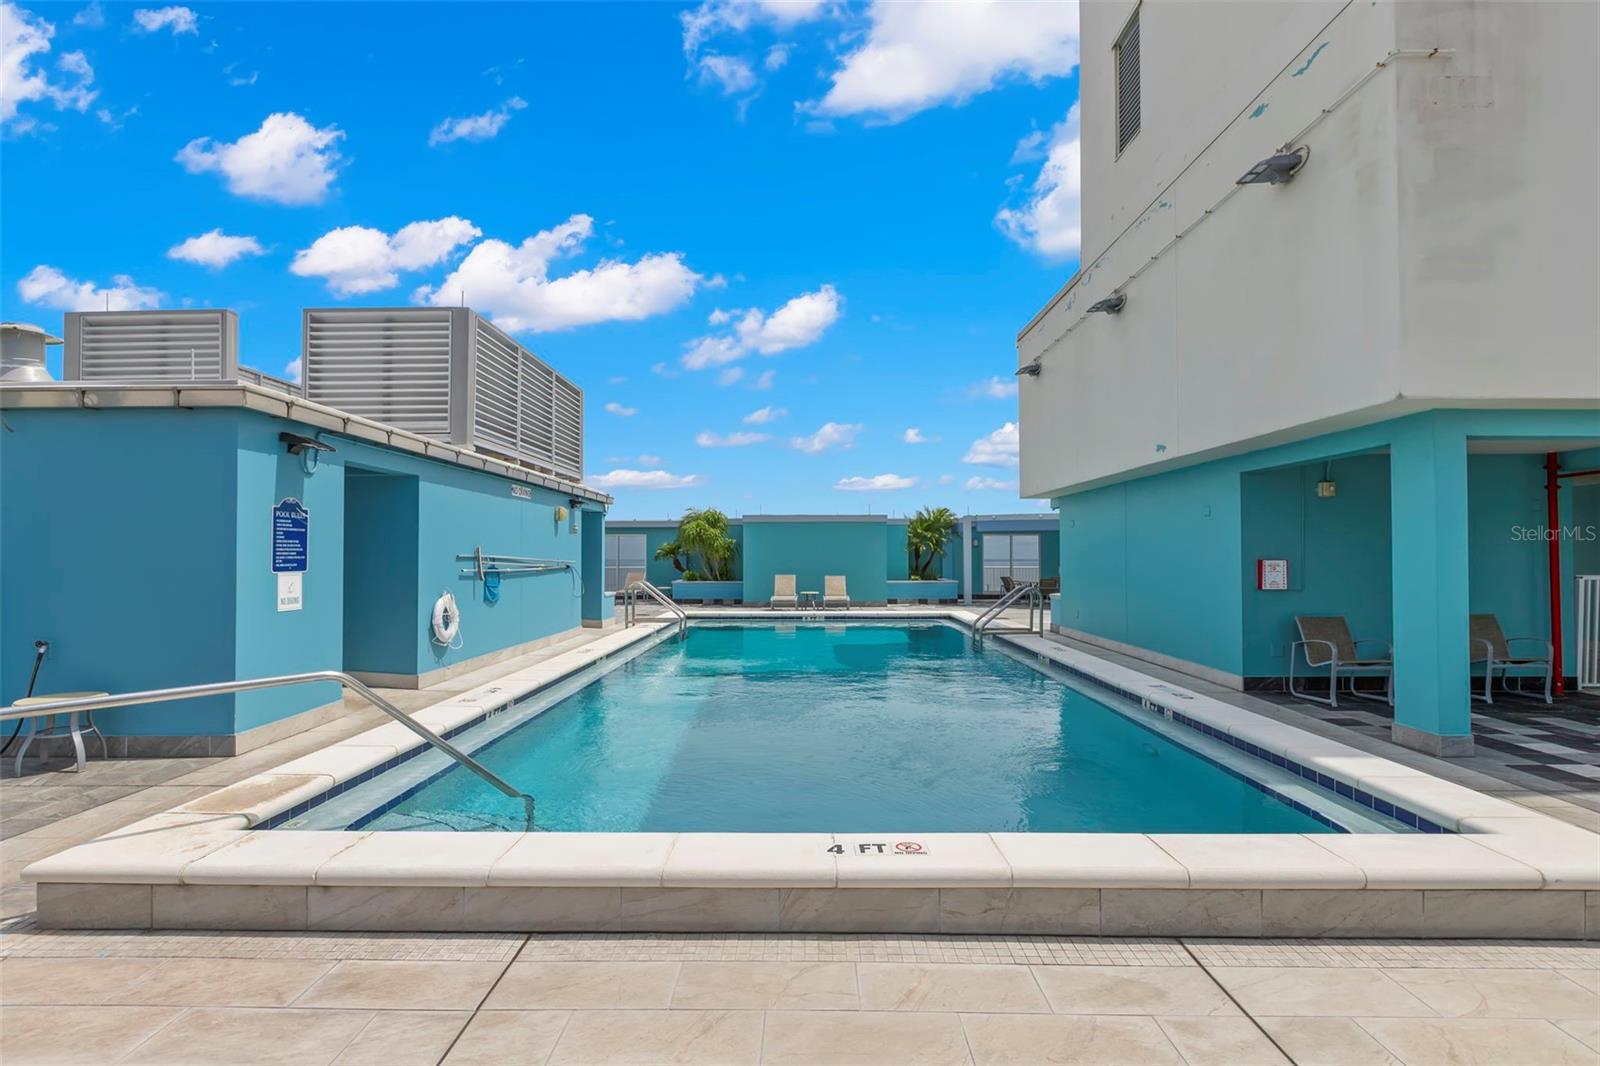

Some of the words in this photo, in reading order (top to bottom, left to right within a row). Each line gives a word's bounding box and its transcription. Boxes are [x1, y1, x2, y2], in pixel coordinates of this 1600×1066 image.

[275, 510, 290, 518] POOL
[827, 844, 845, 855] 4
[859, 843, 886, 854] FT
